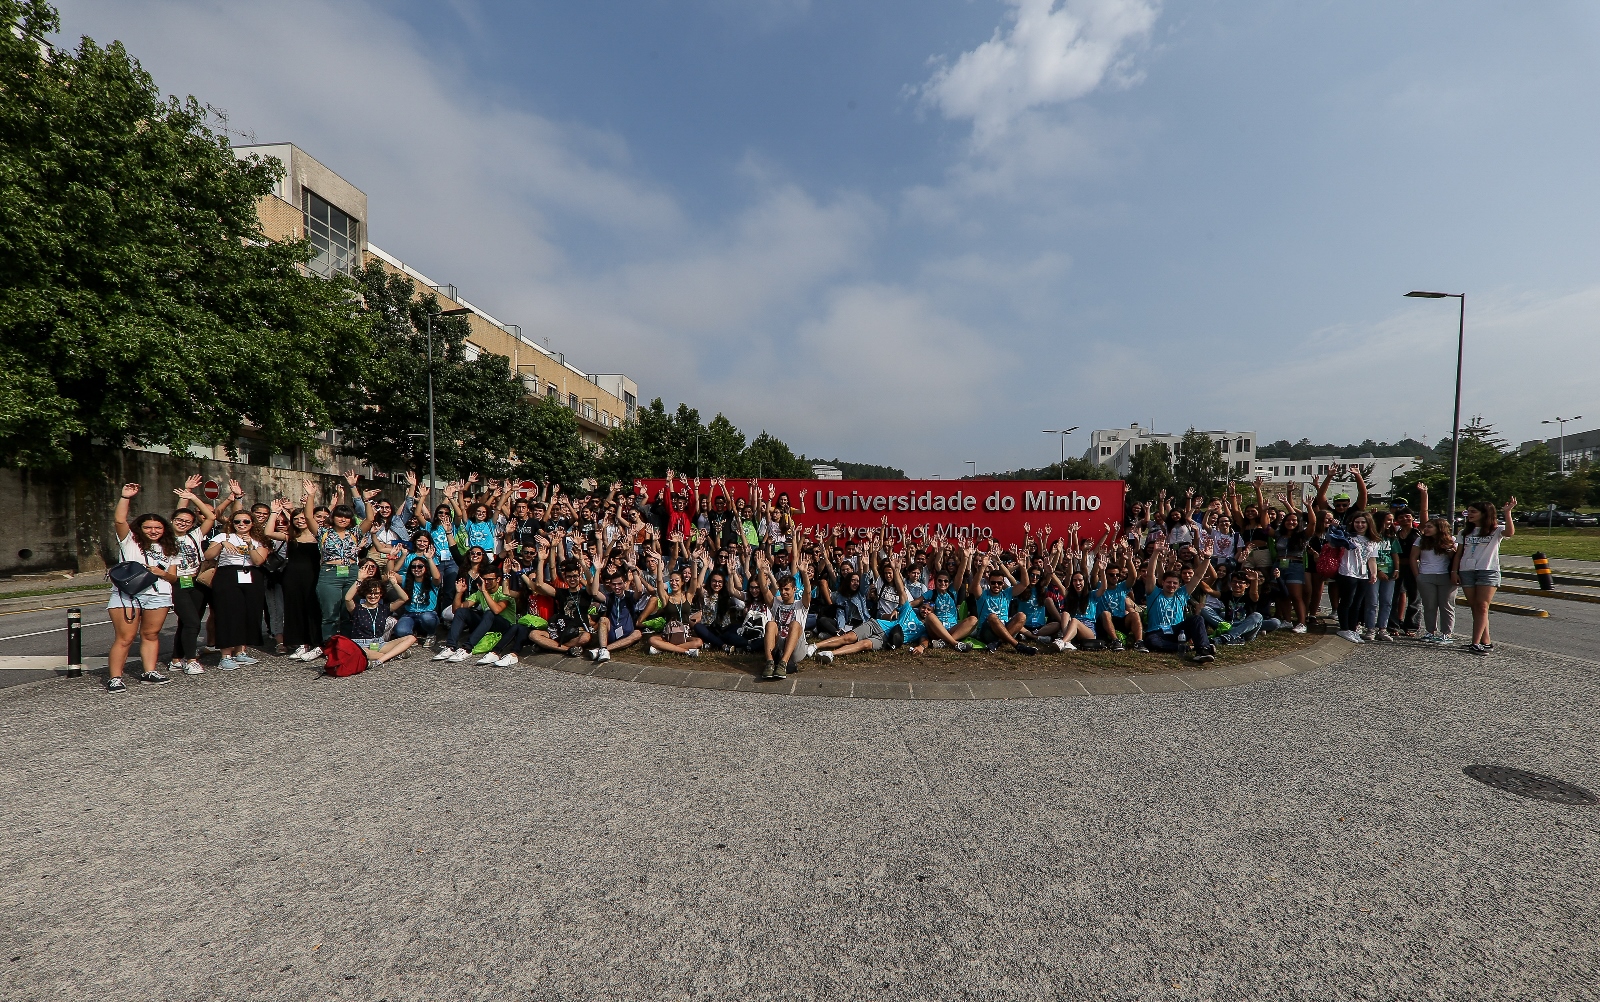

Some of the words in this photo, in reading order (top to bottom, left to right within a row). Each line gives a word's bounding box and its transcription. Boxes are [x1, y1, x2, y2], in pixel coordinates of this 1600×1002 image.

[816, 490, 977, 511] Universidade
[985, 490, 1015, 511] do
[1025, 490, 1101, 511] Minho
[938, 523, 992, 539] Minho
